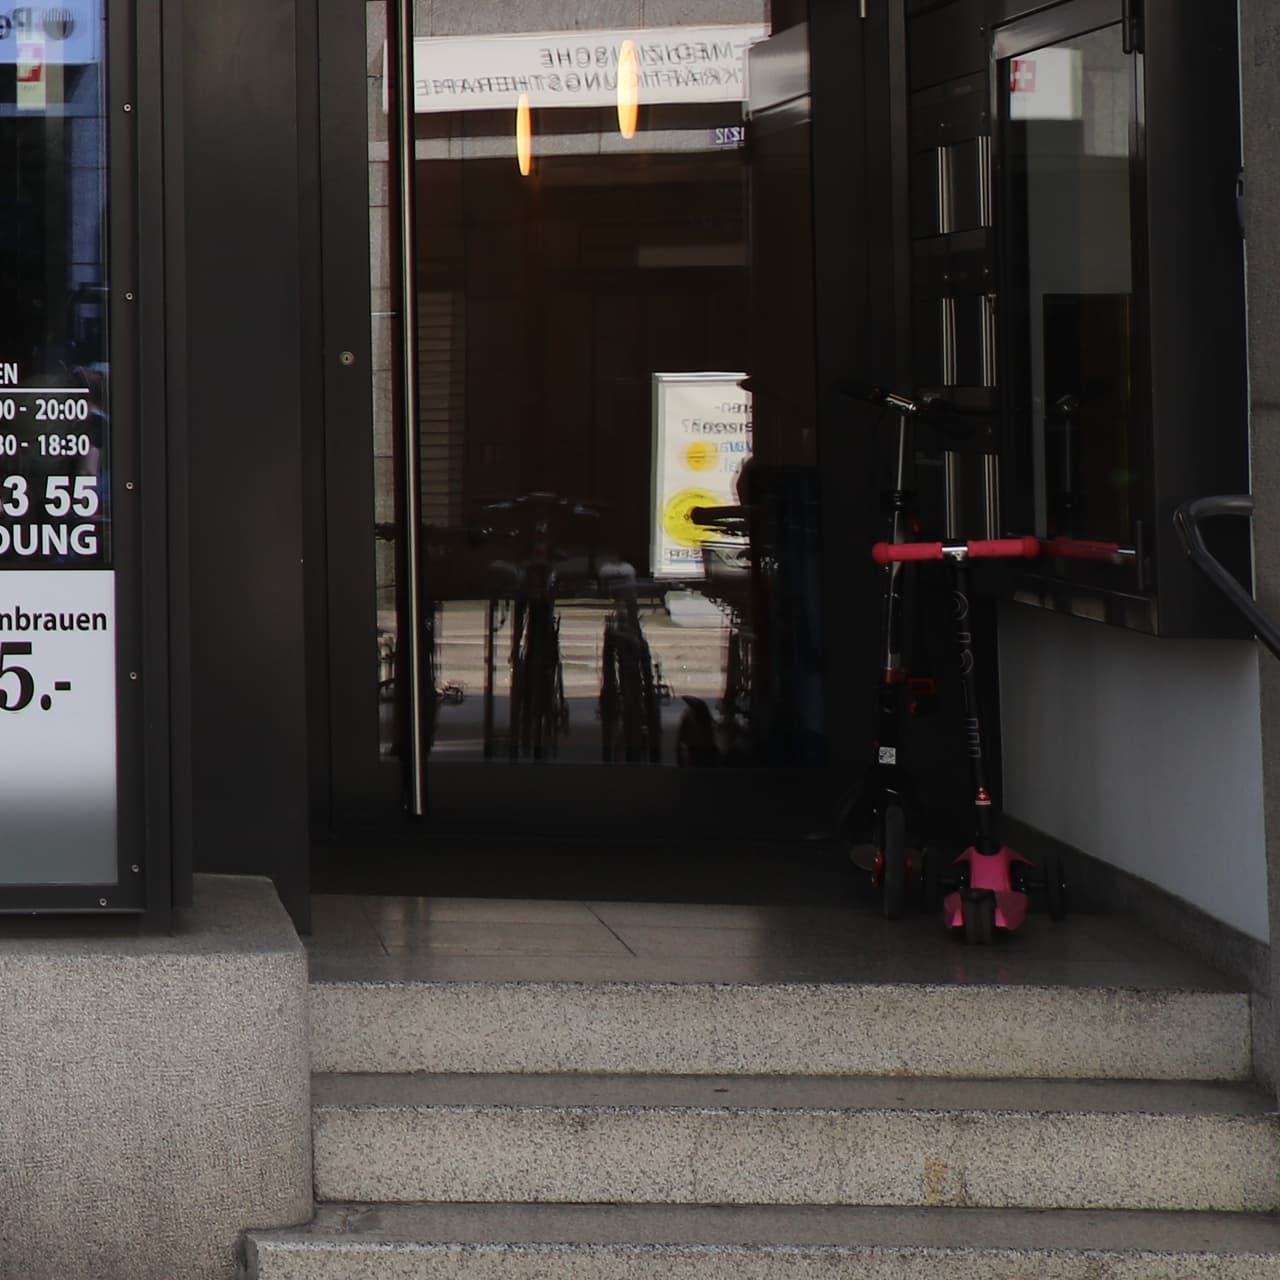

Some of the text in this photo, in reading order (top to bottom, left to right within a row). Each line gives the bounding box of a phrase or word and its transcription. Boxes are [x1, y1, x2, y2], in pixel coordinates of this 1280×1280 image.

[35, 398, 88, 420] 20:00
[37, 433, 90, 456] 18:30
[44, 475, 99, 517] 55
